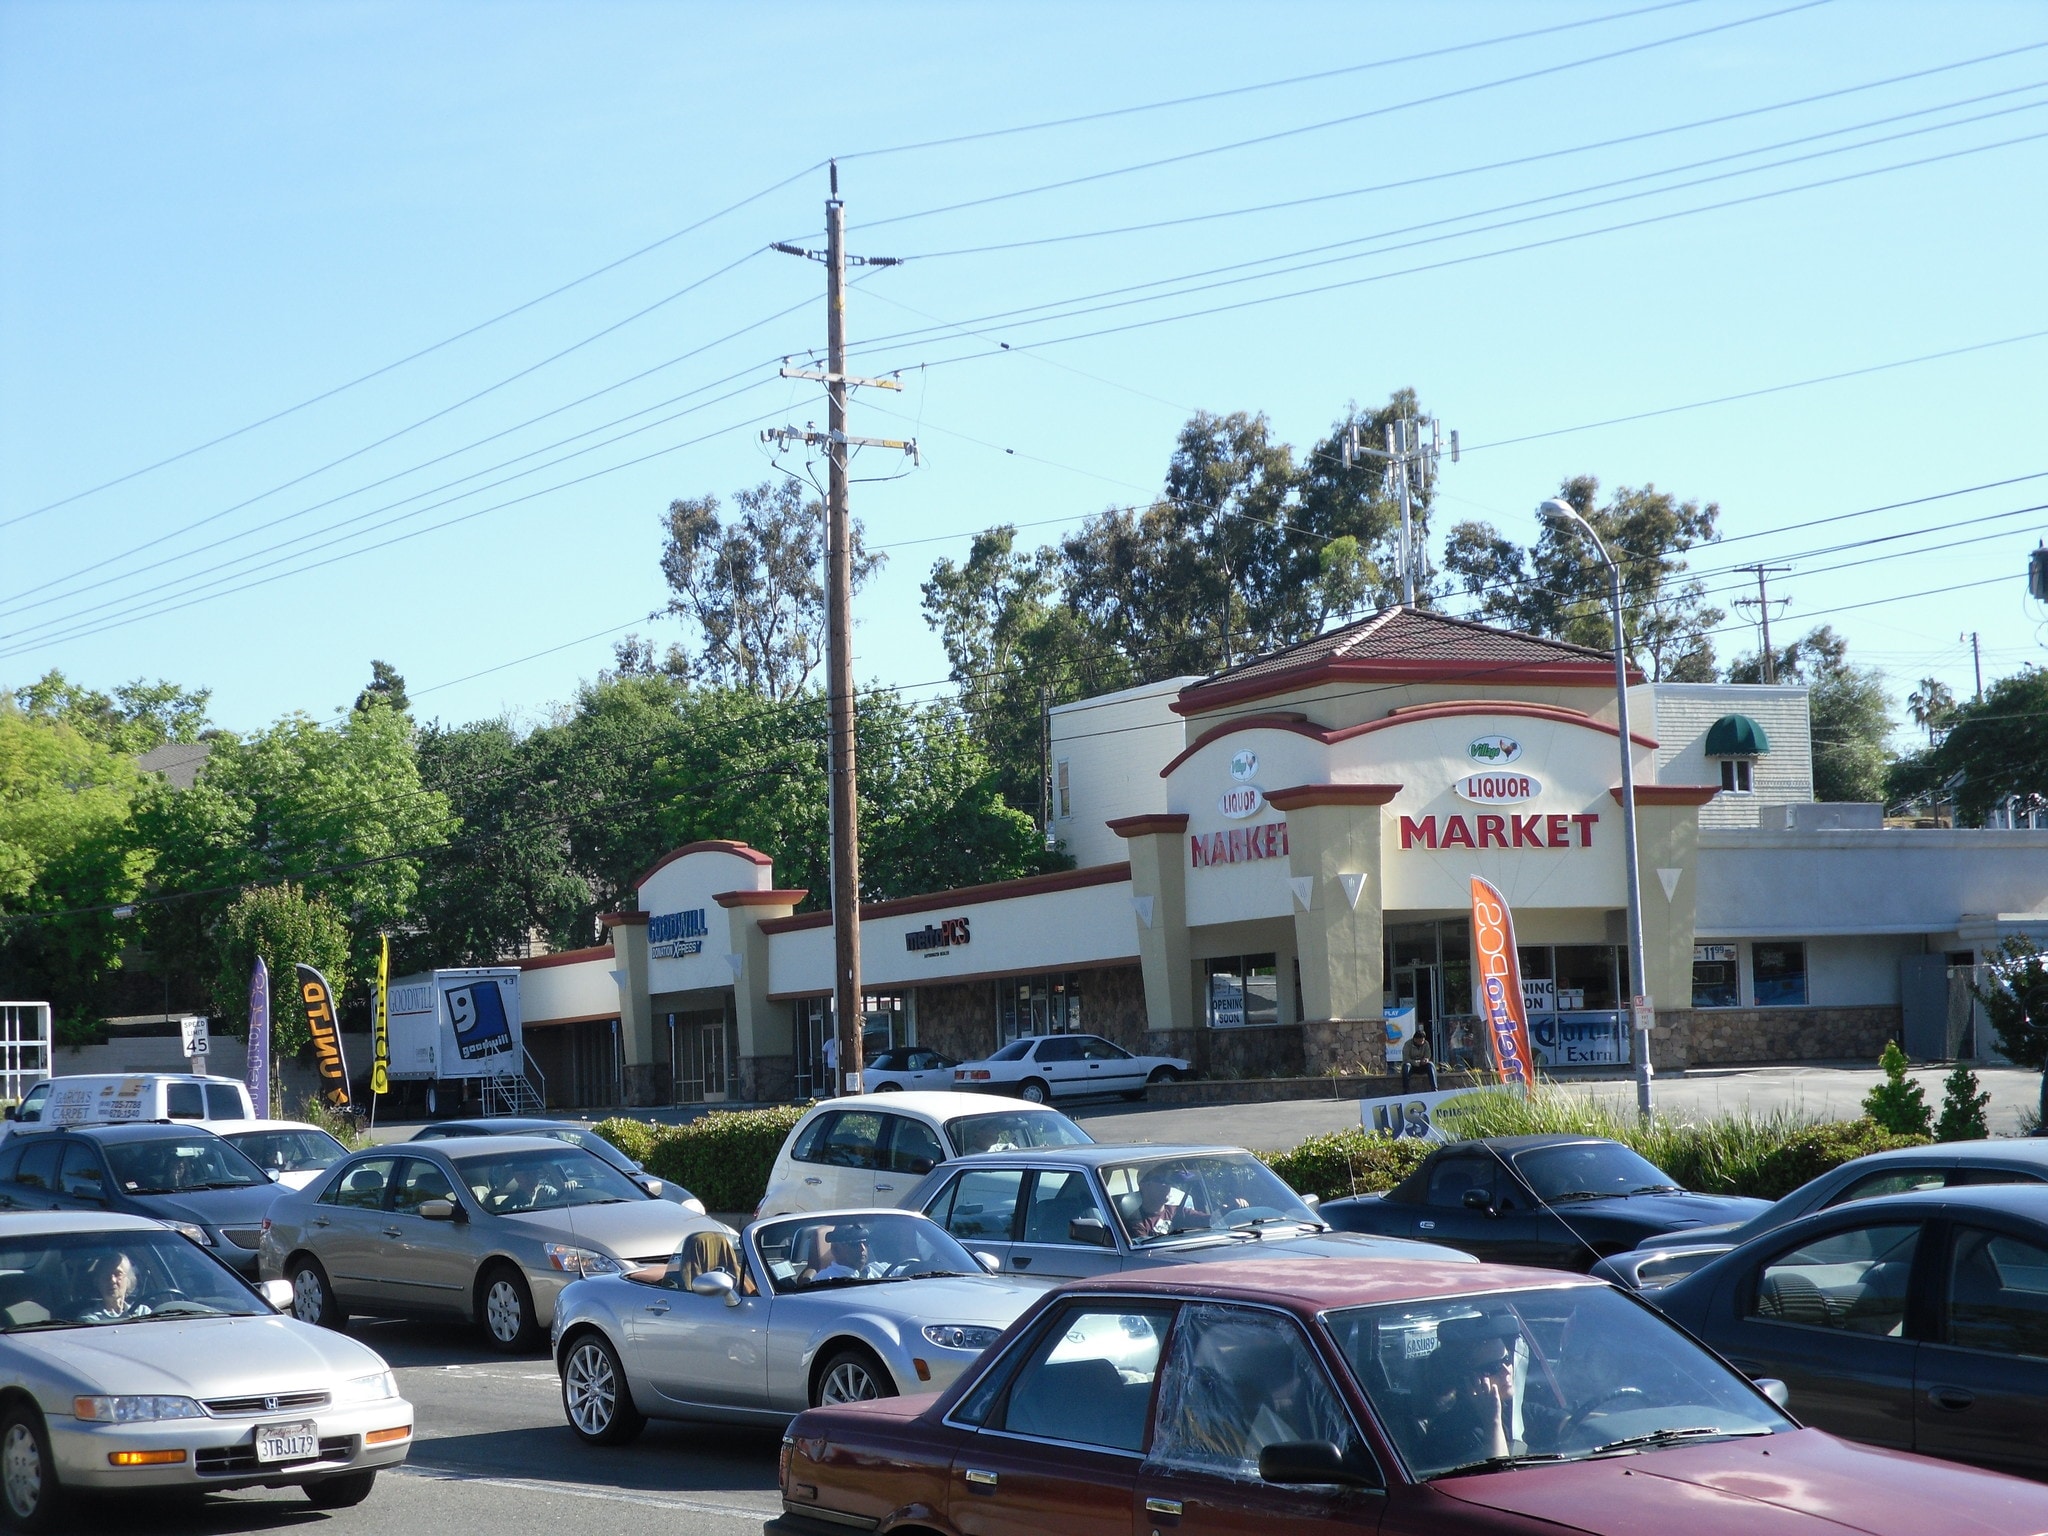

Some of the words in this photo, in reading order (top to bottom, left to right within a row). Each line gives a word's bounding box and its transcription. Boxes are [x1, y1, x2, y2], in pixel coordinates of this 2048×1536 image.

[1471, 743, 1500, 760] Village
[1468, 778, 1530, 799] LIQUOR
[1223, 790, 1256, 814] LIQUOR
[1399, 813, 1600, 849] MARKET
[1190, 821, 1289, 868] MARKET
[648, 909, 708, 944] GOODWILL
[905, 917, 970, 951] metroPCS
[388, 987, 434, 1012] GOODWILL
[184, 1020, 205, 1028] SPEED
[1219, 1013, 1239, 1024] SOON
[186, 1038, 207, 1052] 45
[462, 1034, 509, 1058] goodwill
[52, 1107, 90, 1119] CARPET
[261, 1436, 314, 1457] 3TBJ179
